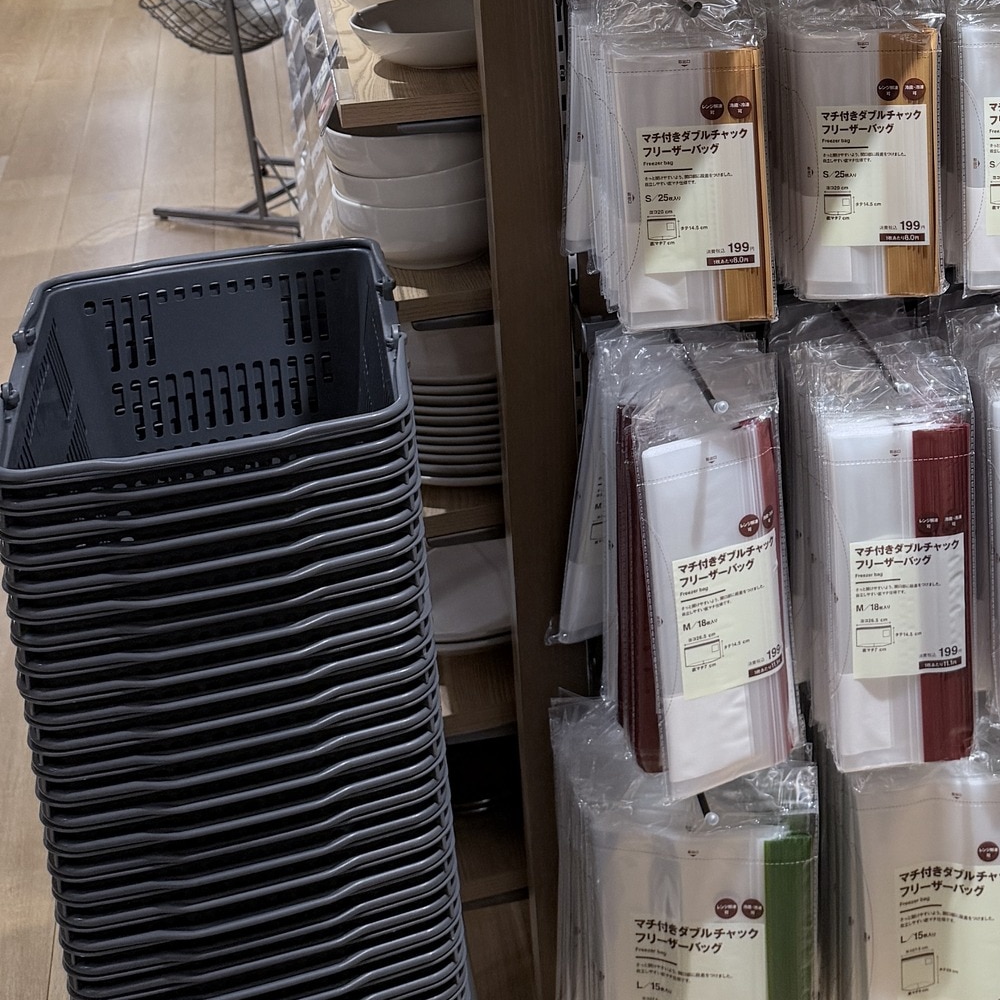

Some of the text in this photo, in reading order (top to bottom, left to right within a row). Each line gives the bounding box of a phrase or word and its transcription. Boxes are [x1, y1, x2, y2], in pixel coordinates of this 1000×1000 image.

[821, 109, 921, 121] マチ付きダブルチャック
[642, 128, 748, 143] マチ付きダブルチャック
[822, 123, 894, 134] フリーザーバッグ
[643, 143, 719, 157] フリーザーバッグ
[678, 537, 774, 574] マチ付きダブルチャック
[855, 540, 960, 556] マチ付きダブルチャック
[856, 554, 932, 570] フリーザーバッグ
[680, 558, 755, 588] フリーザーバッグ
[900, 880, 984, 897] フリーザーバッグ
[635, 919, 759, 939] マチ付きダブルチャック
[636, 932, 723, 954] フリーザーバッグ
